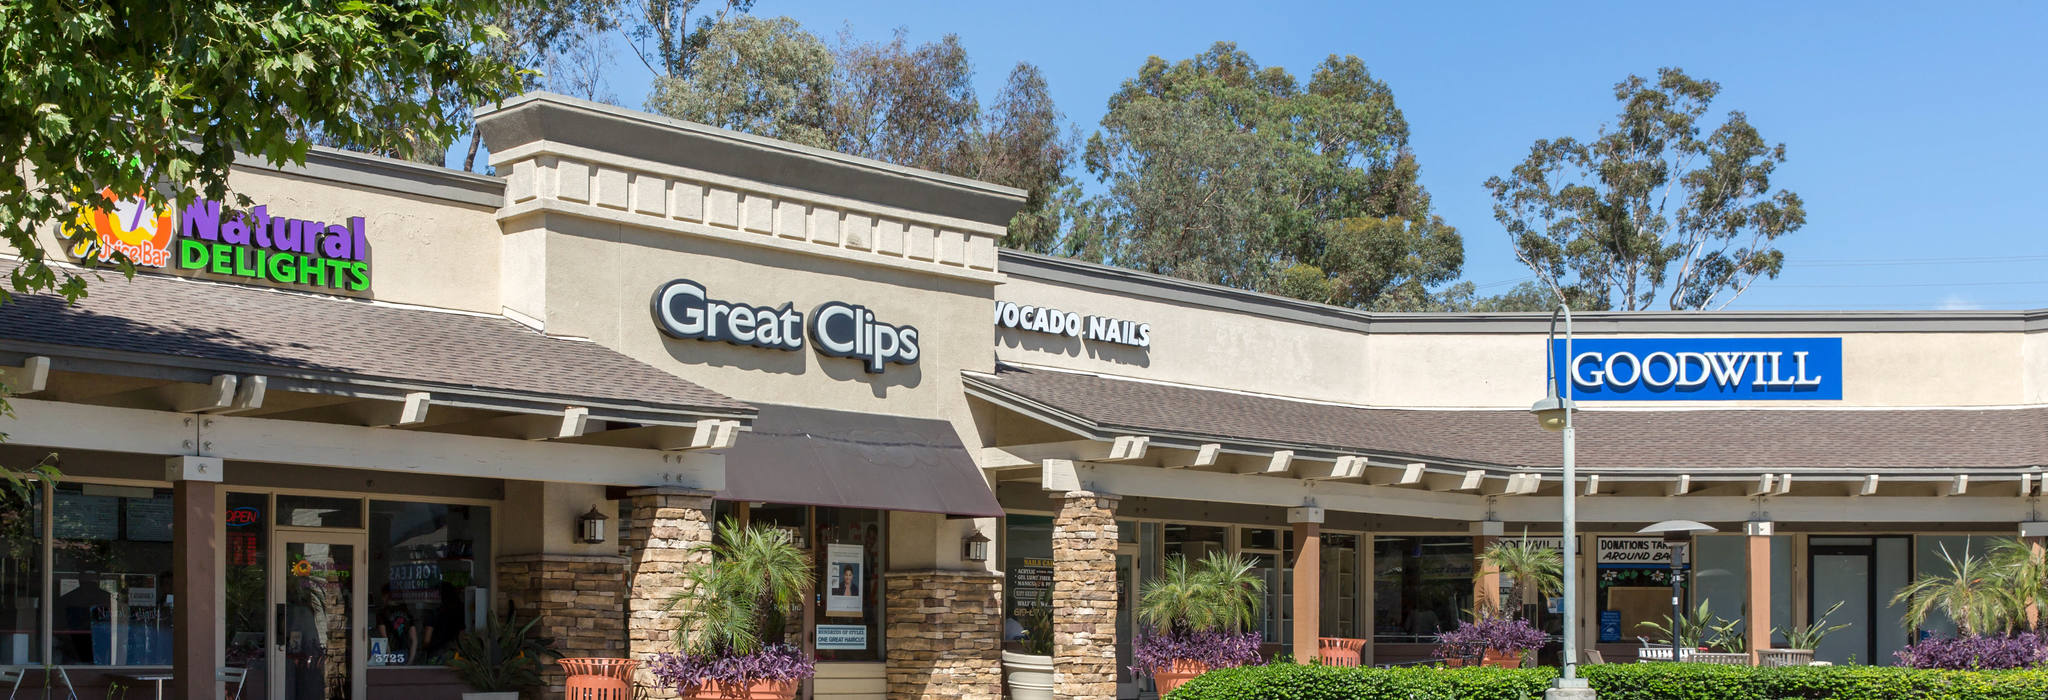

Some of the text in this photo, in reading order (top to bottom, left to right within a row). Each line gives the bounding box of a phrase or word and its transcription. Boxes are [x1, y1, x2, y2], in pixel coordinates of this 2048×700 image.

[182, 195, 366, 260] Natural
[142, 240, 170, 266] Bar
[181, 239, 370, 291] DELIGHTS
[661, 282, 919, 370] Great Clips
[1088, 315, 1150, 347] NAILS
[1571, 351, 1822, 386] GOODWILL
[226, 510, 257, 522] OPEN
[1601, 540, 1649, 550] DONATIONS
[1603, 551, 1650, 561] AROUND
[371, 642, 381, 656] A
[375, 653, 405, 663] 3723
